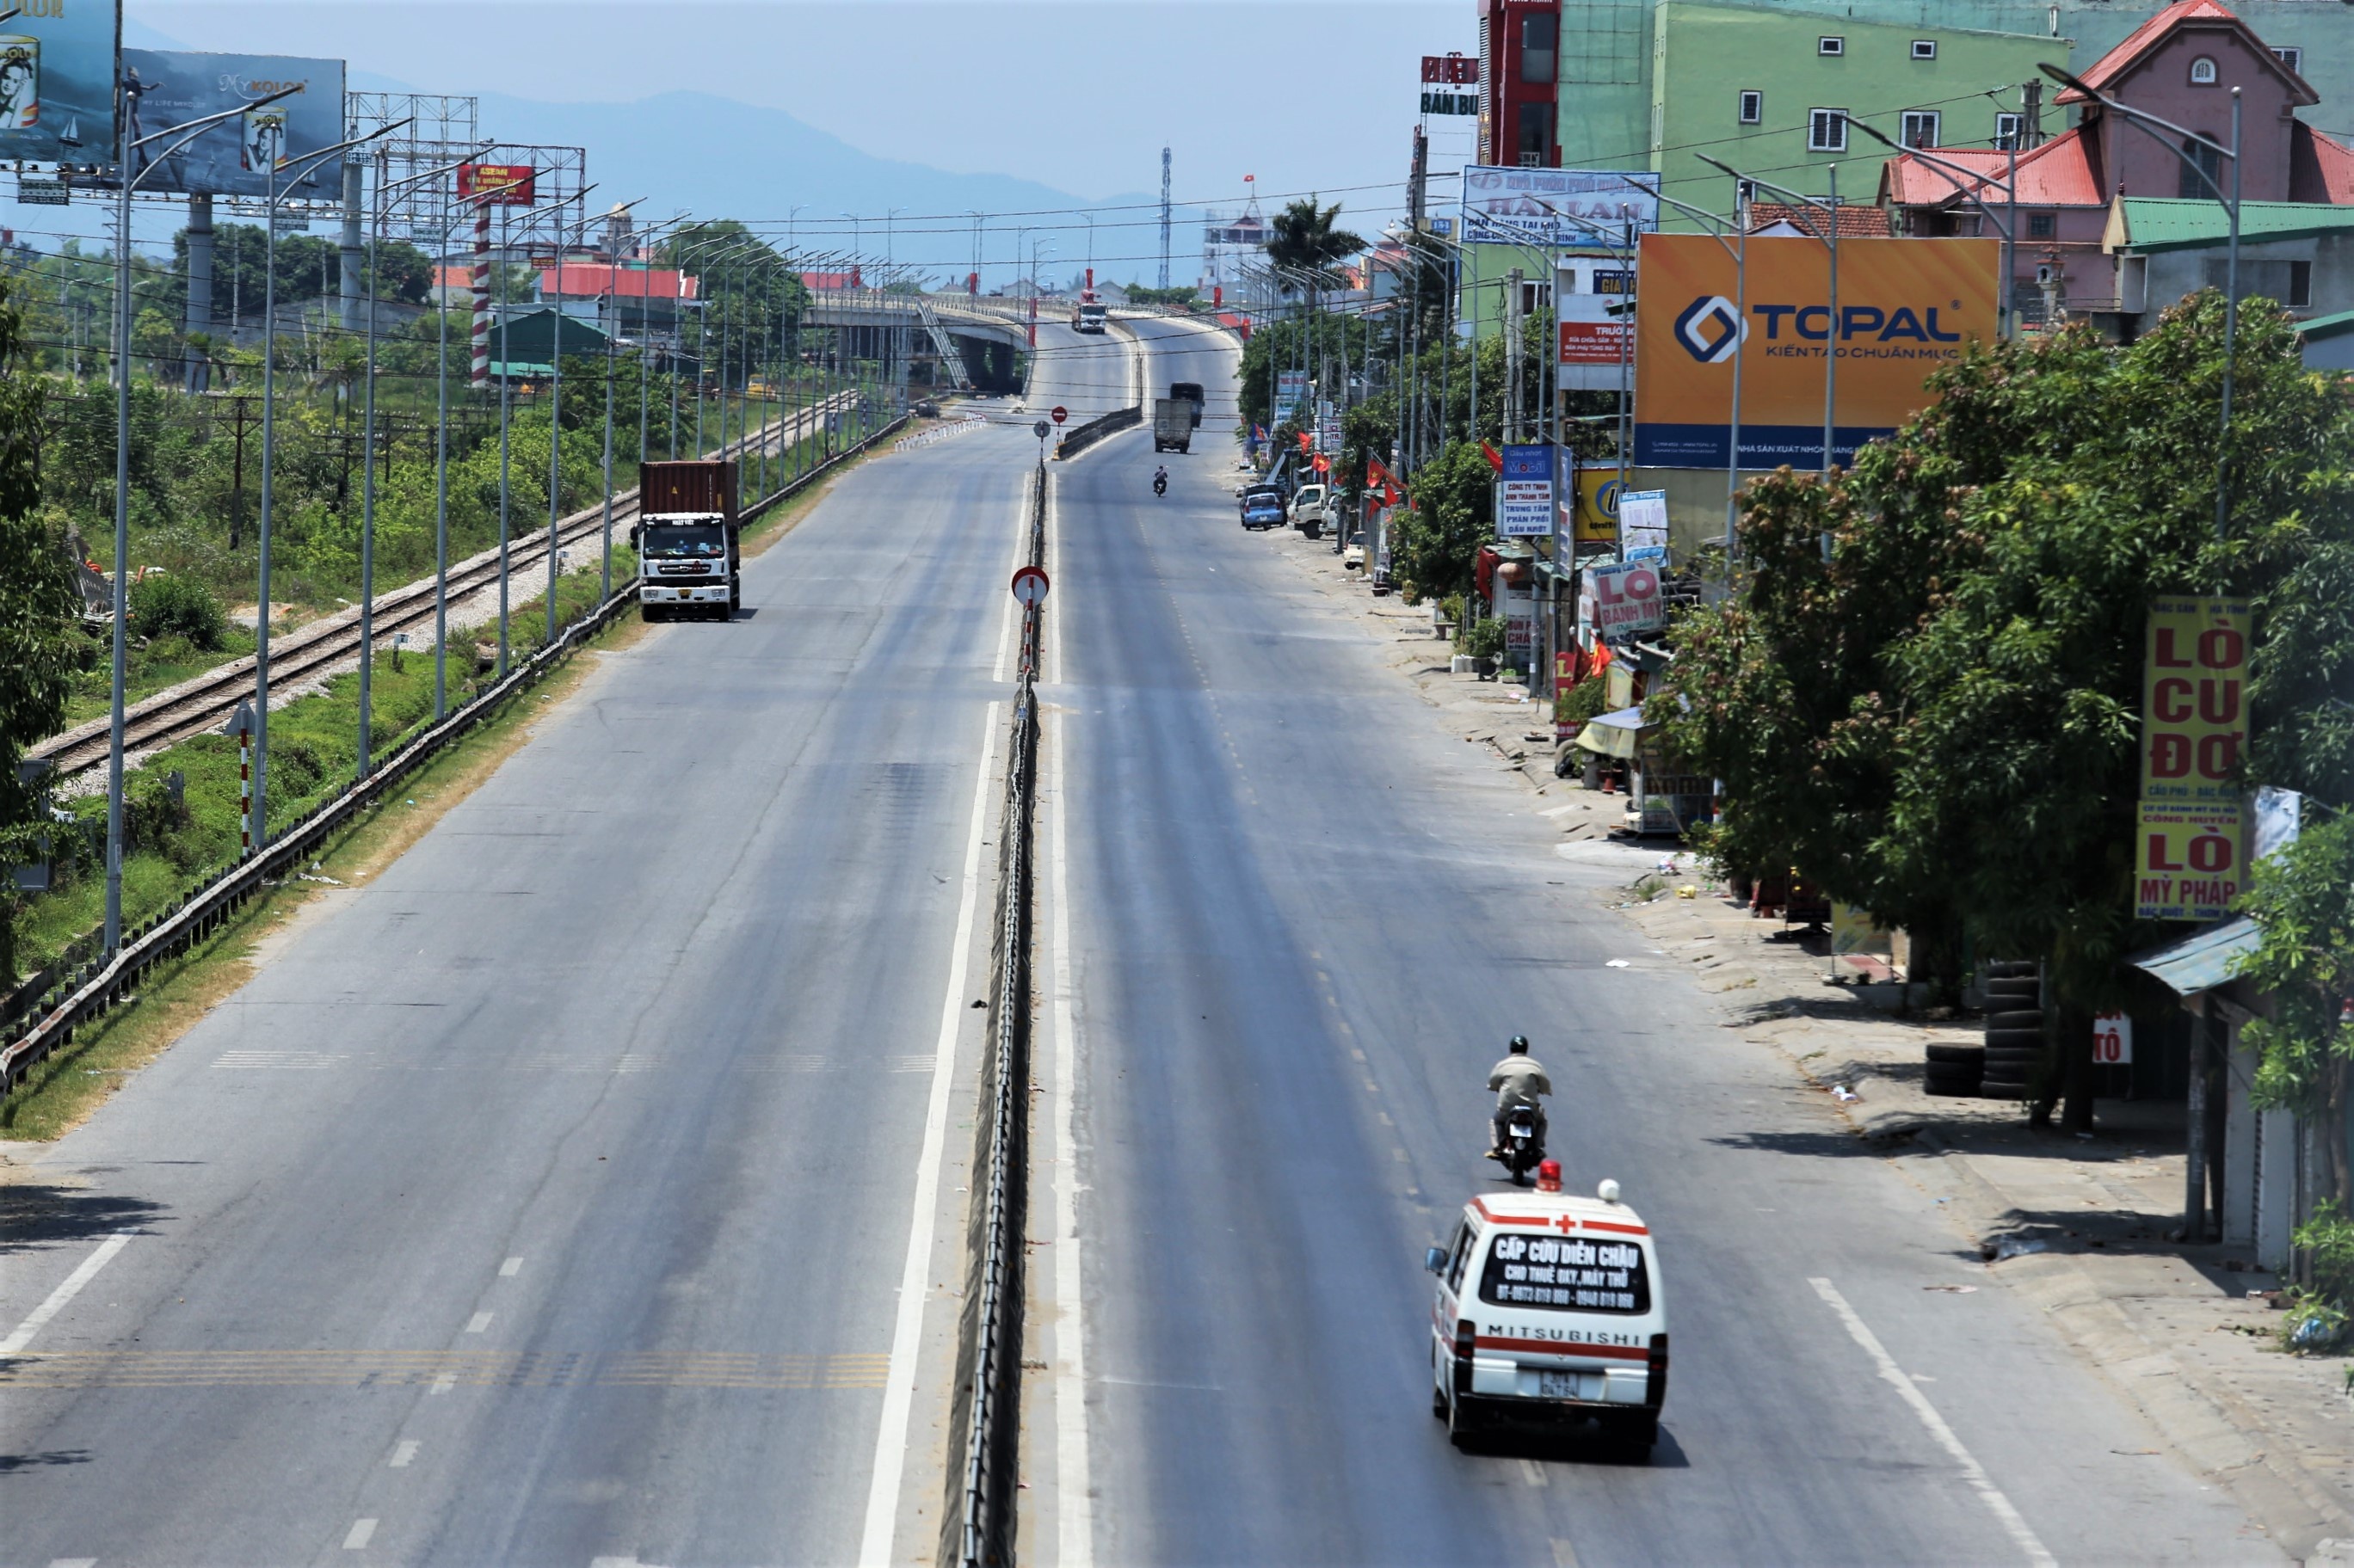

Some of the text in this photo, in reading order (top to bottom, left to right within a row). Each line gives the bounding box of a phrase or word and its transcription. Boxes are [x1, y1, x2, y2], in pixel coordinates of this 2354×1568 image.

[1566, 199, 1642, 221] LAN
[1602, 279, 1621, 292] GIA
[1753, 304, 1960, 342] TOPAL
[1508, 460, 1545, 473] Mobil
[1598, 563, 1657, 606] LÒ
[1603, 605, 1639, 625] BÁNH
[2155, 618, 2244, 669] LÒ
[2154, 677, 2240, 725] CU
[2148, 731, 2244, 781] ĐƠ
[2148, 826, 2233, 873] LÒ
[2179, 876, 2237, 906] PHÁP
[2092, 1027, 2121, 1061] TÔ
[1495, 1236, 1526, 1261] CẤP
[1599, 1243, 1638, 1269] CHÂU
[1505, 1264, 1527, 1282] CHO
[1529, 1266, 1556, 1284] THUÊ
[1488, 1325, 1639, 1346] MITSUBISHI
